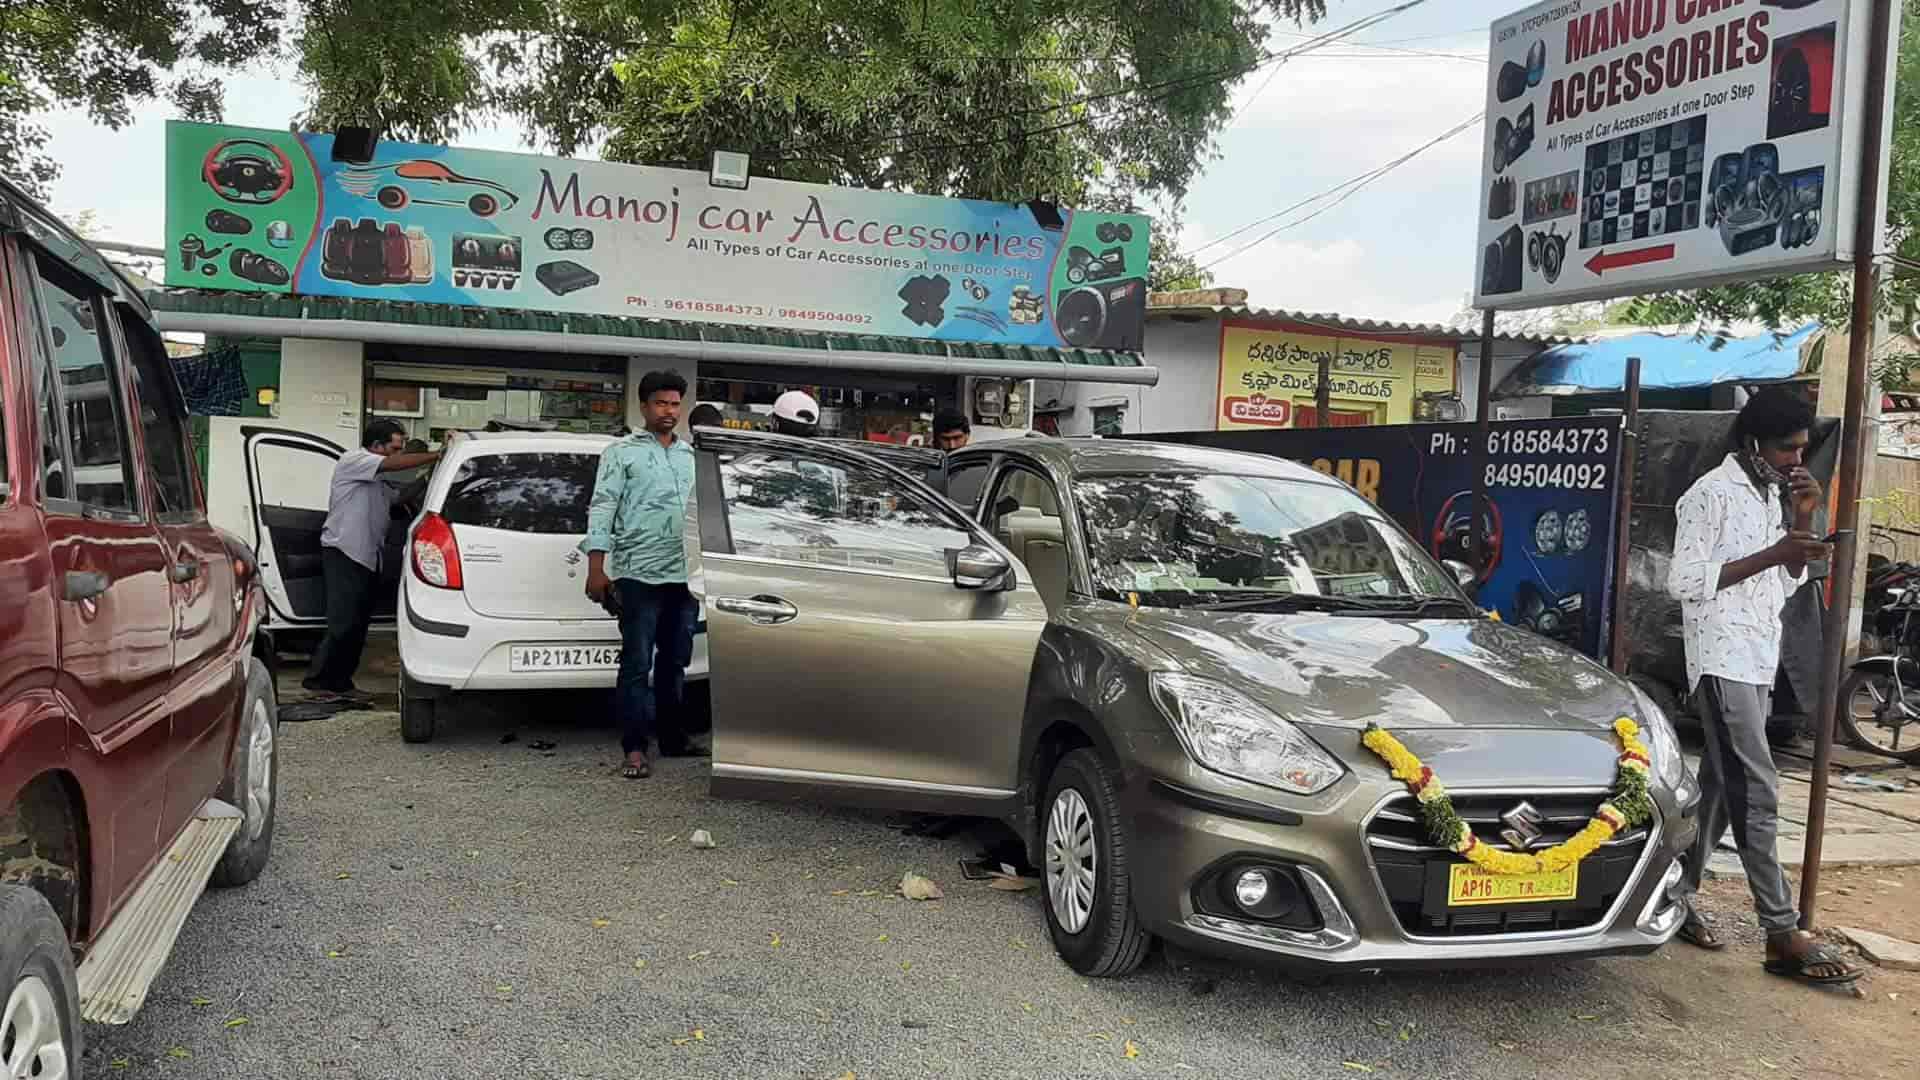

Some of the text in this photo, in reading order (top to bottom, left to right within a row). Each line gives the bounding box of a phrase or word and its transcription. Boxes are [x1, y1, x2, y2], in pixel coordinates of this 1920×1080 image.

[1565, 0, 1666, 64] MANOJ
[1546, 10, 1769, 125] ACCESSORIES
[1546, 83, 1755, 152] All Types of Car Accessories at one Door Step
[531, 168, 1044, 259] Manoj car Accessories
[687, 238, 1033, 281] All Types of Car Accessories at one Door Step
[626, 296, 647, 307] Ph
[664, 299, 763, 316] 9618584373
[778, 308, 872, 324] 9849504092
[1430, 432, 1456, 454] Ph
[1487, 428, 1609, 454] 618584373
[1484, 463, 1606, 489] 849504092
[1461, 879, 1492, 897] AP16
